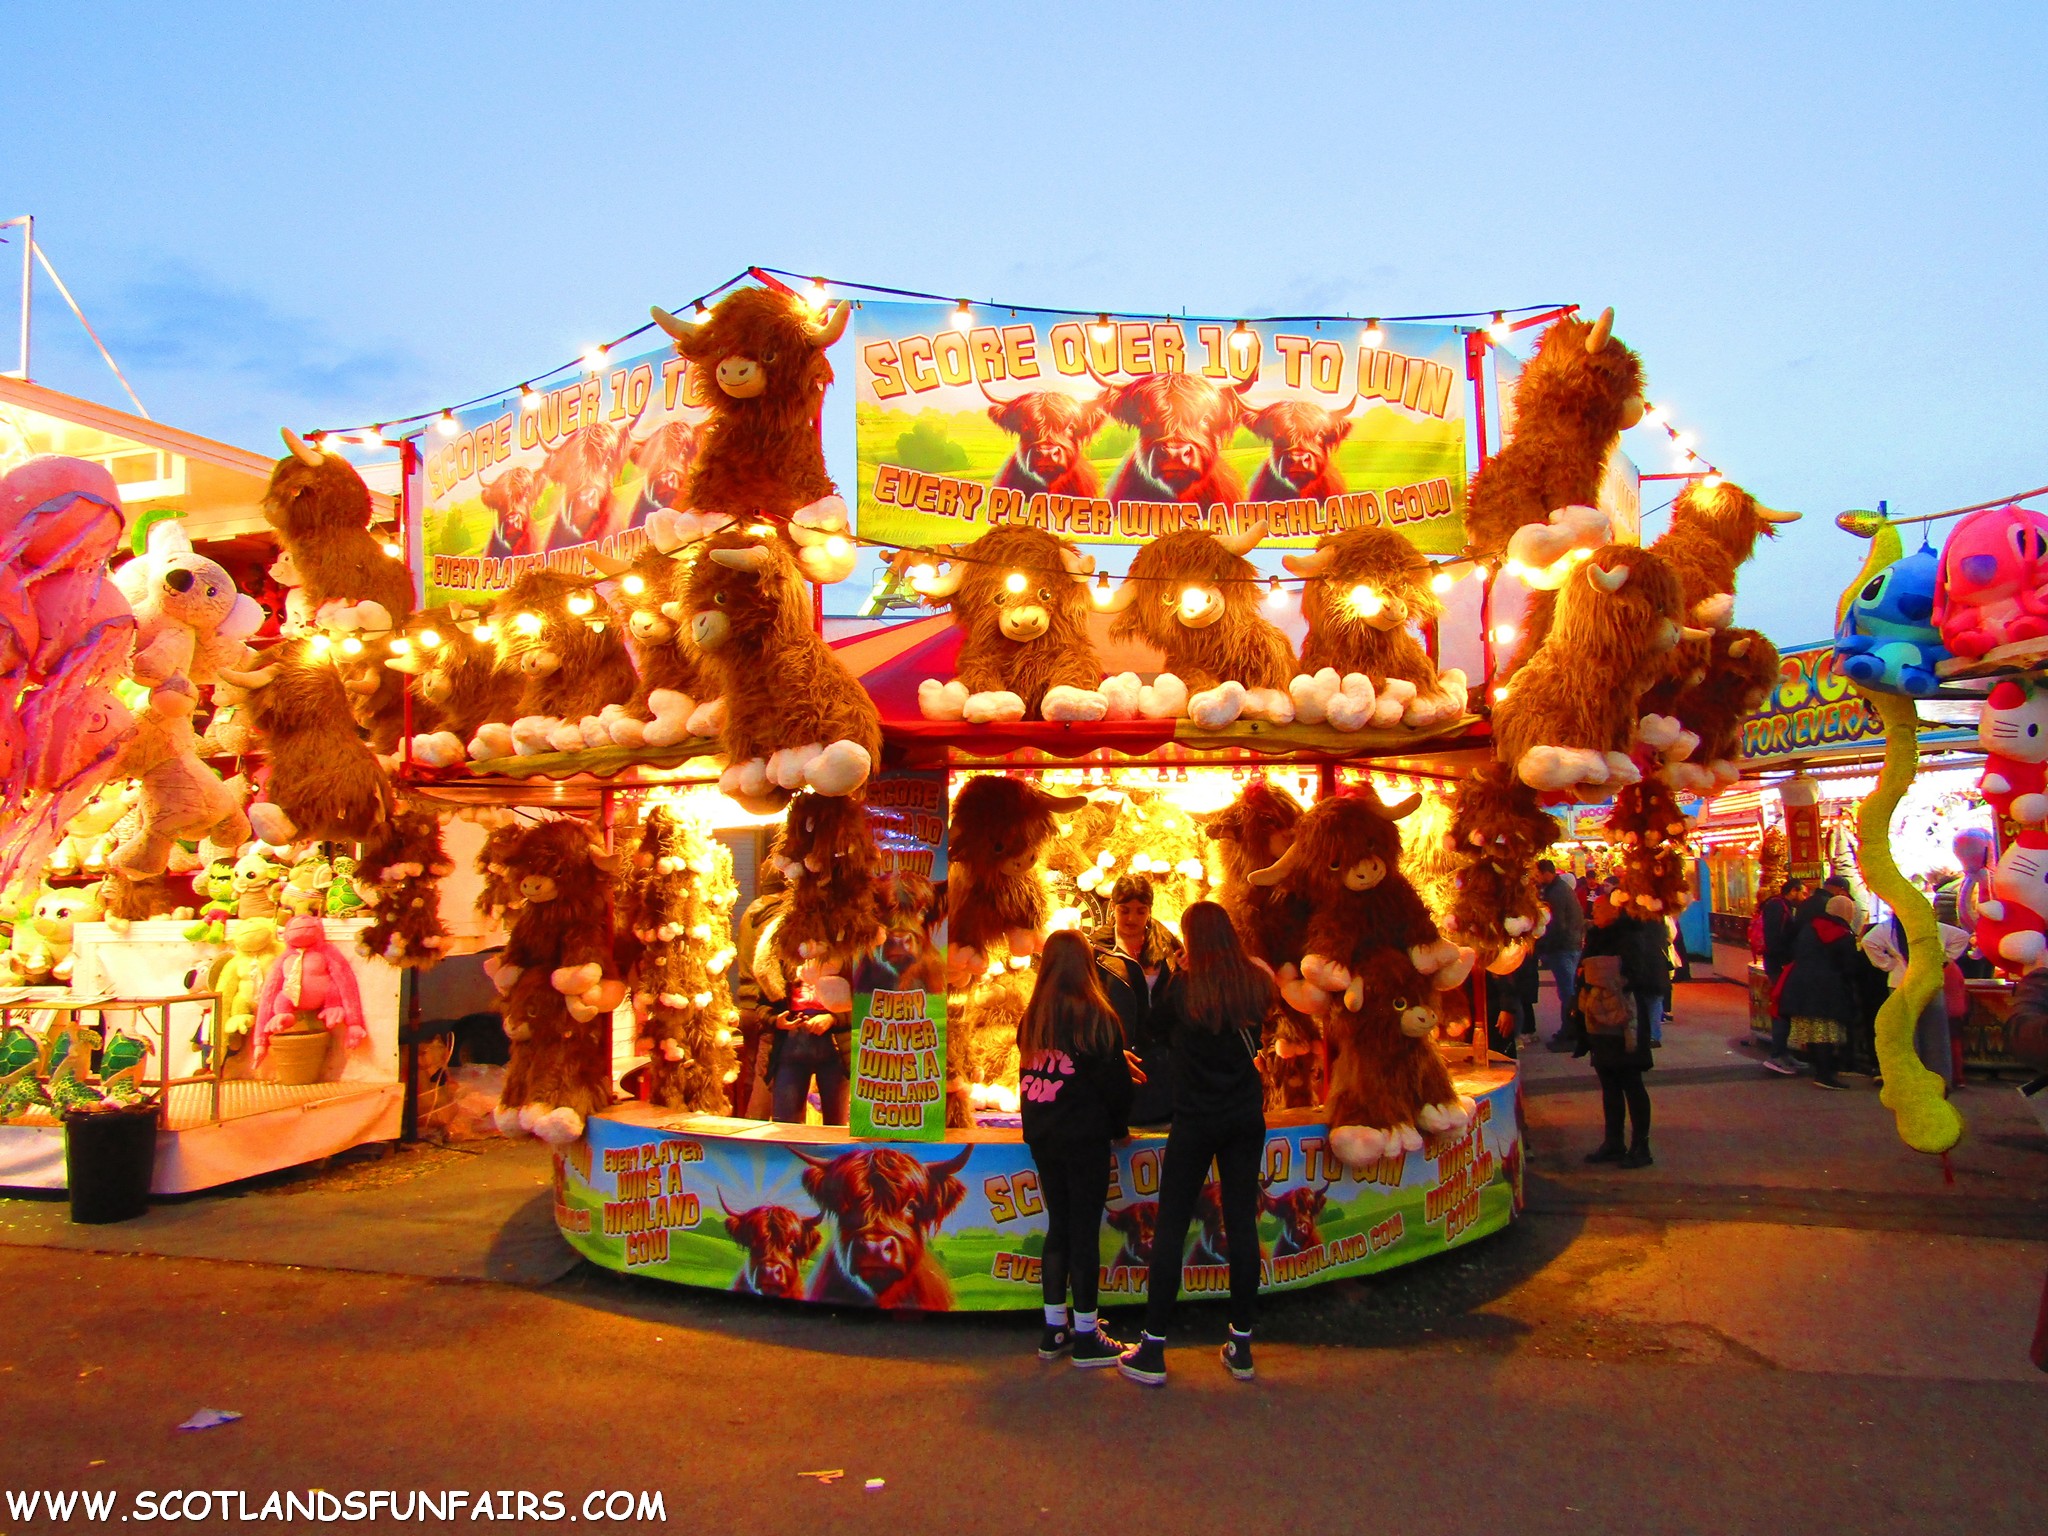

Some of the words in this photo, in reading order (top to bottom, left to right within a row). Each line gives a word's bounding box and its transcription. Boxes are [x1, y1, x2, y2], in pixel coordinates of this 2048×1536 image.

[864, 325, 1041, 400] SCORE
[1049, 322, 1185, 377] OVER
[1198, 326, 1261, 382] 10
[1275, 335, 1343, 394] TO
[1357, 346, 1454, 419] WIN
[428, 412, 513, 500] SCORE
[519, 378, 602, 451] OVER
[608, 364, 653, 422] 10
[873, 464, 983, 521] EVERY
[987, 488, 1112, 535] PLAYER
[1120, 501, 1202, 538] WINS
[1209, 504, 1231, 536] A
[1234, 492, 1383, 538] HIGHLAND
[1387, 478, 1452, 525] COW
[434, 555, 480, 590] EVERY
[1743, 714, 1792, 755] FOR
[866, 780, 939, 811] SCORE
[917, 814, 943, 846] 10
[898, 849, 934, 878] WIN
[871, 989, 926, 1020] EVERY
[861, 1018, 938, 1052] PLAYER
[858, 1048, 918, 1081] WINS
[922, 1049, 941, 1080] A
[857, 1077, 941, 1103] HIGHLAND
[1020, 1075, 1064, 1103] FOX
[871, 1102, 923, 1127] COW
[604, 1148, 639, 1172] EVERY
[640, 1140, 704, 1169] PLAYER
[1438, 1132, 1474, 1184] WINS
[1476, 1125, 1486, 1158] A
[618, 1165, 662, 1202] WINS
[667, 1162, 682, 1194] A
[1426, 1151, 1493, 1224] HIGHLAND
[604, 1192, 700, 1235] HIGHLAND
[1446, 1191, 1479, 1242] COW
[626, 1229, 669, 1266] COW
[1272, 1230, 1368, 1284] HIGHLAND
[1369, 1211, 1405, 1252] COW
